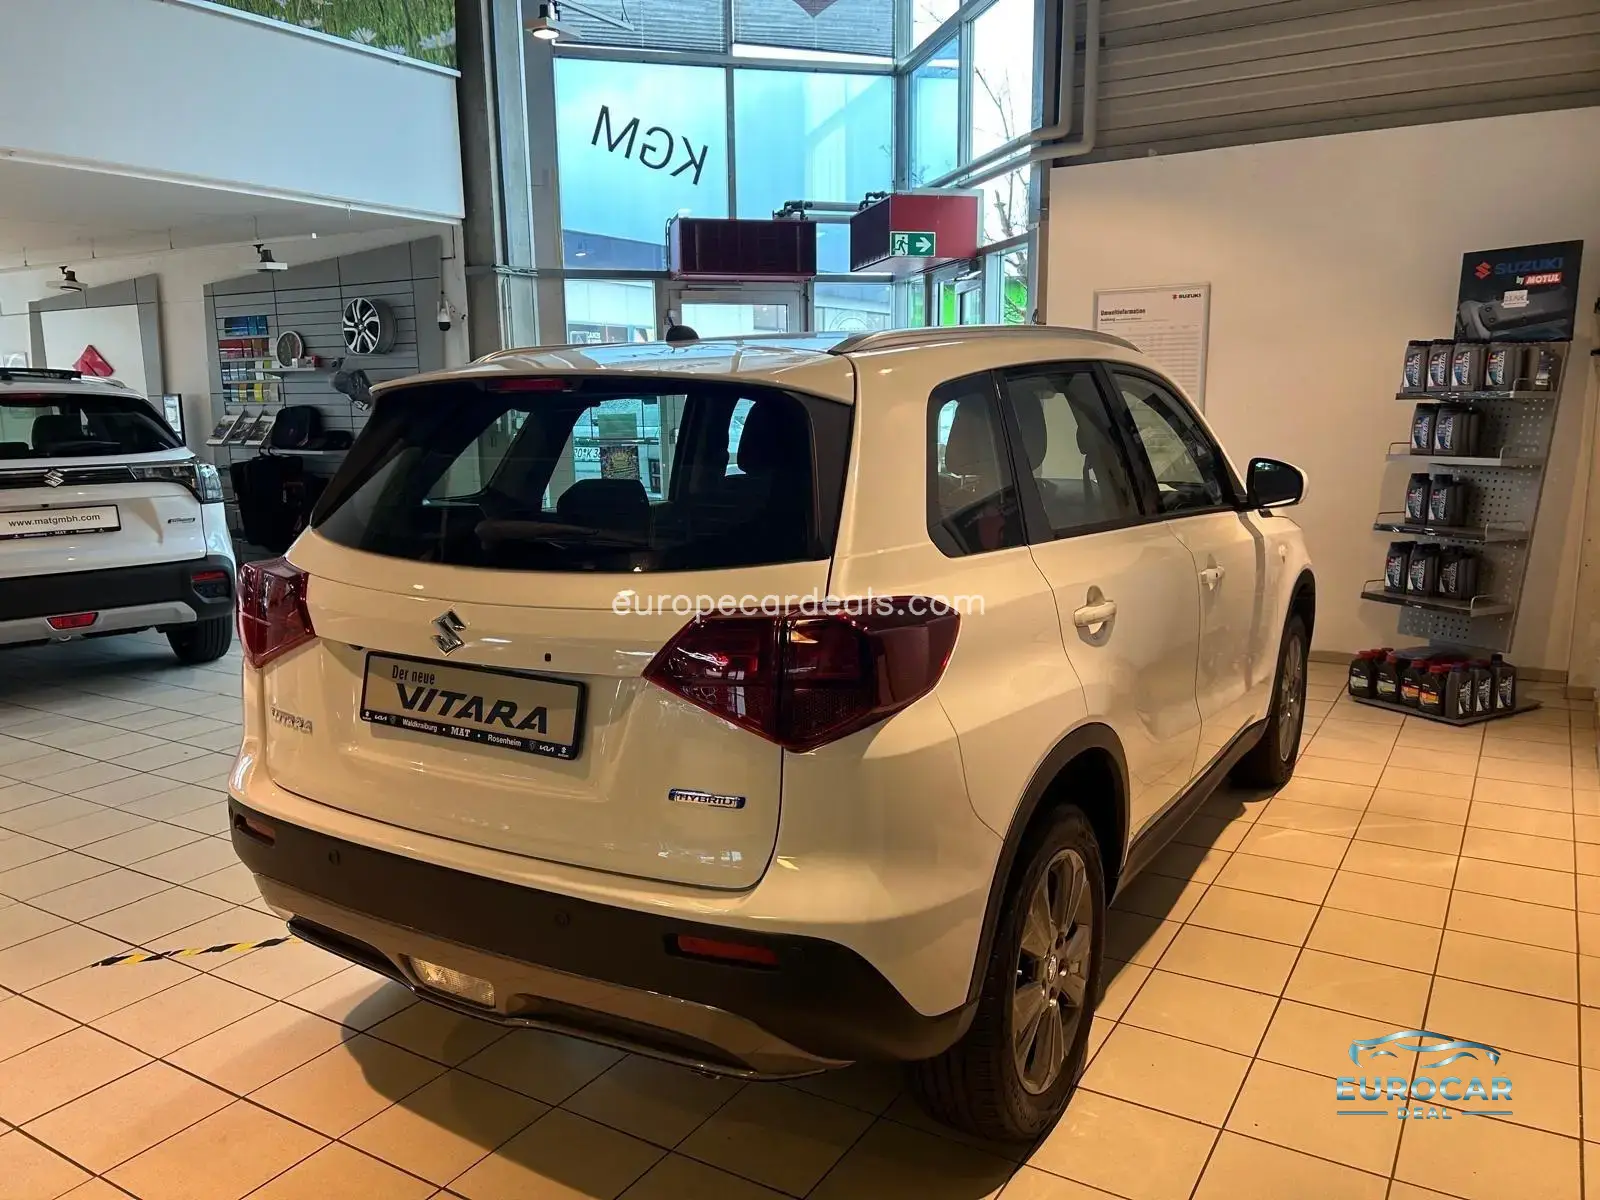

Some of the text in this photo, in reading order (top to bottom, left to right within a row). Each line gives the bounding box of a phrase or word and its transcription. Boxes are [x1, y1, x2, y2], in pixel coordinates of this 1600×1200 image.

[1494, 257, 1564, 275] SUZUKI
[1516, 273, 1561, 285] by MOTUL
[8, 513, 101, 528] www.matgmbh.com
[392, 664, 436, 685] Der neue
[396, 683, 547, 734] VITARA
[402, 718, 438, 733] Waldkraiburg
[450, 726, 471, 738] MAT
[487, 734, 522, 747] Rosenheim
